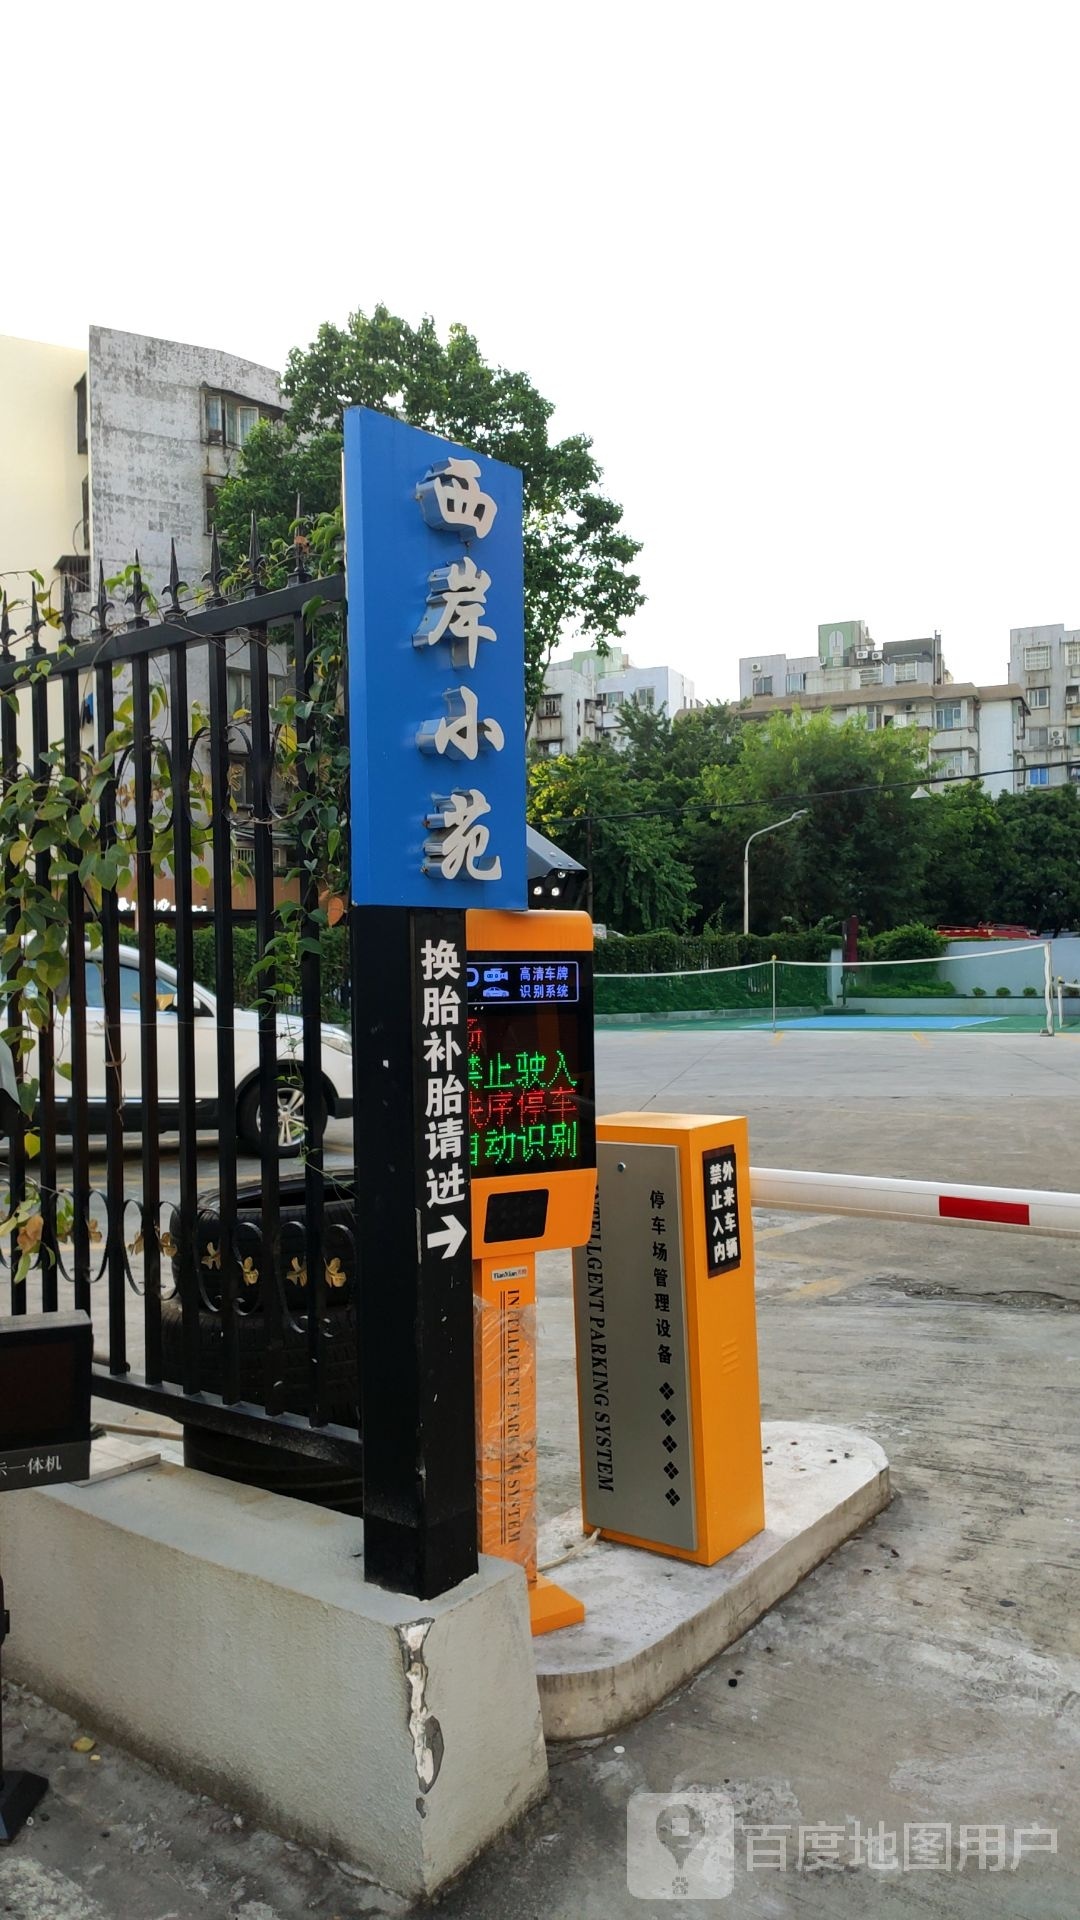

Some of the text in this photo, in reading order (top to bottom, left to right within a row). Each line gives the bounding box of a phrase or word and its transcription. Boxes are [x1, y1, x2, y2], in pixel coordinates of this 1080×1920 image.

[424, 457, 505, 881] 西岸小苑
[519, 966, 569, 981] 高清车牌
[519, 984, 569, 999] 识别系统
[421, 940, 466, 1209] 换胎补胎请进
[709, 1163, 726, 1263] 禁止入内
[722, 1161, 738, 1259] 外来车辆
[650, 1190, 672, 1365] 停车场管理设备
[590, 1315, 609, 1407] PARKING
[594, 1411, 614, 1492] SYSTEM
